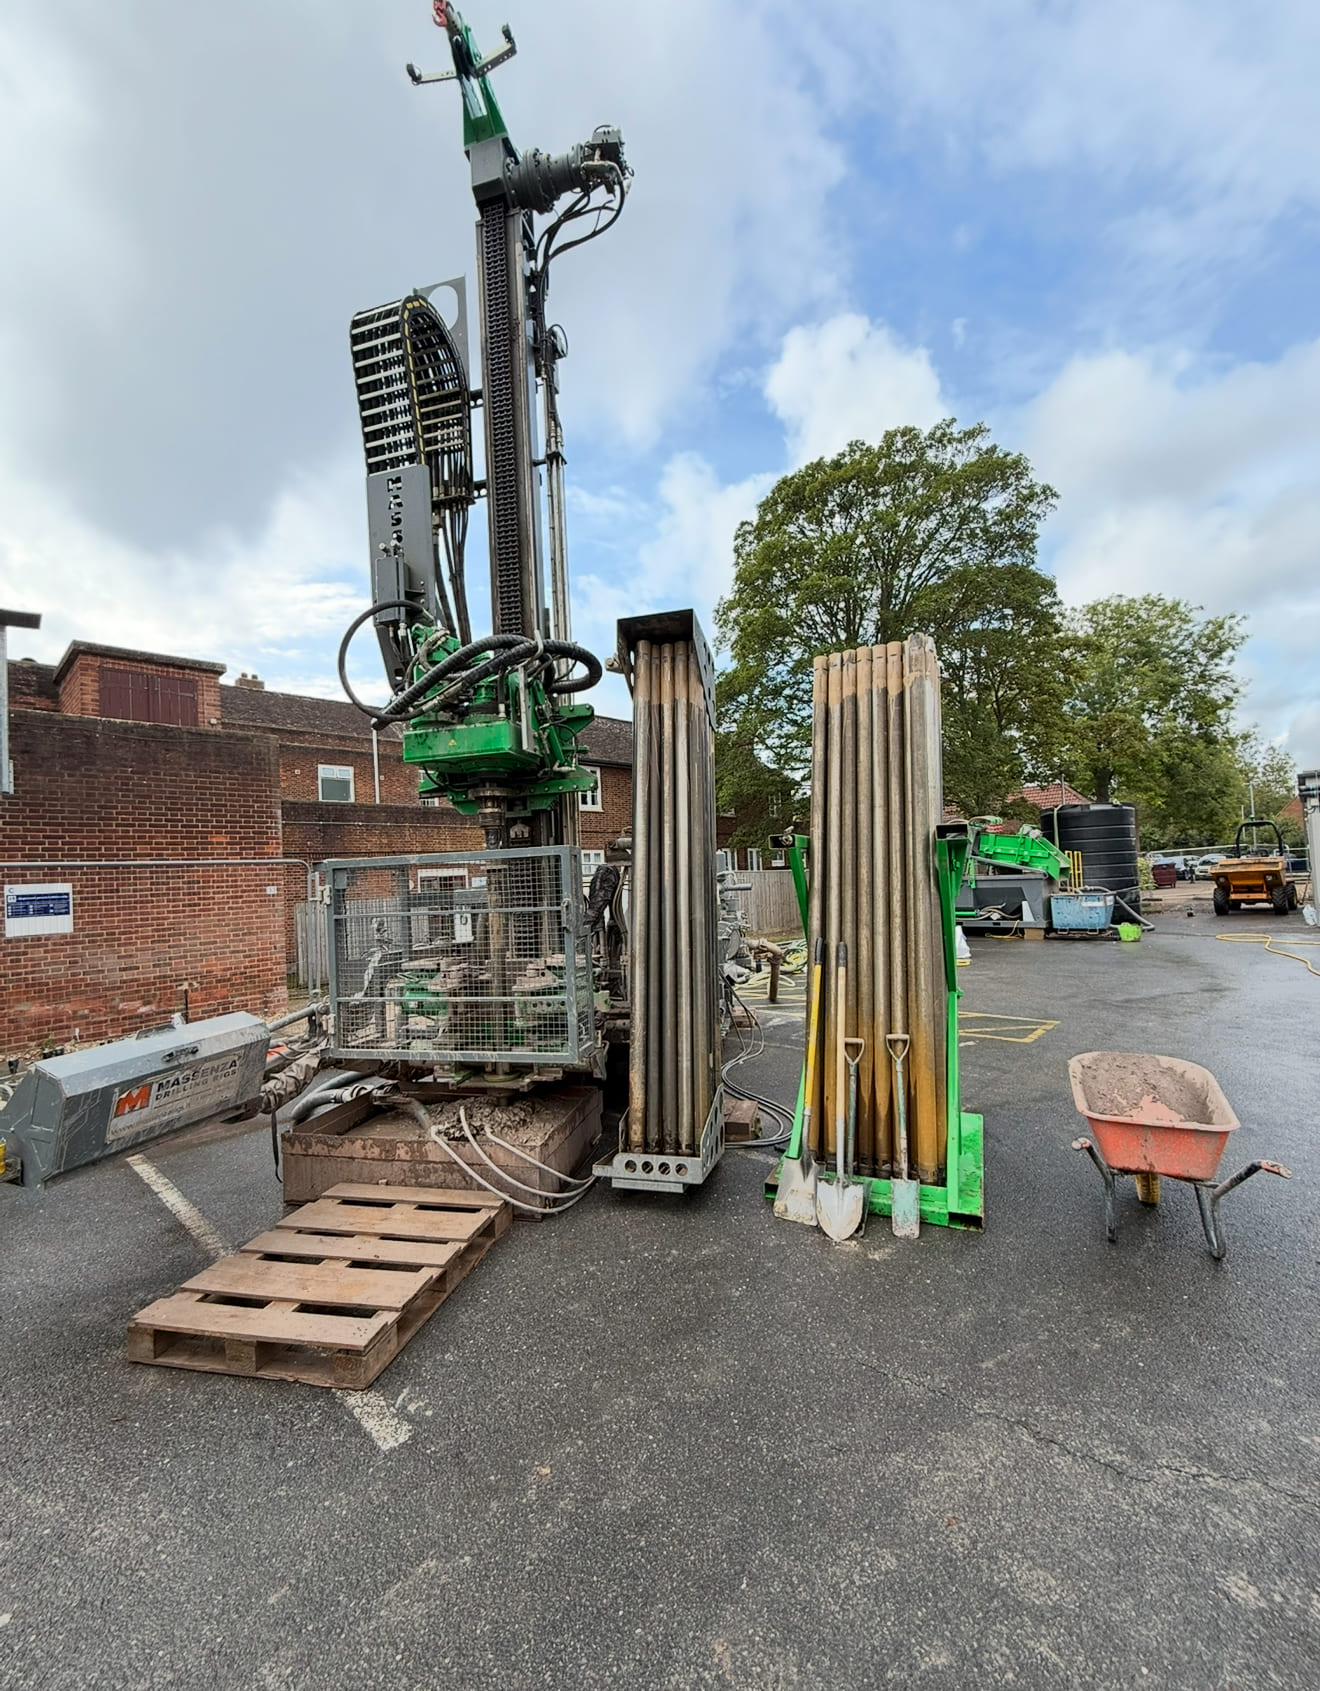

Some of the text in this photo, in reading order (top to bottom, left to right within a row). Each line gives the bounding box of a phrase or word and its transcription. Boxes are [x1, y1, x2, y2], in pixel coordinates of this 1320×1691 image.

[155, 1069, 237, 1101] DRILLING RIGS
[156, 1060, 238, 1092] MASSENZA
[116, 1083, 152, 1117] M
